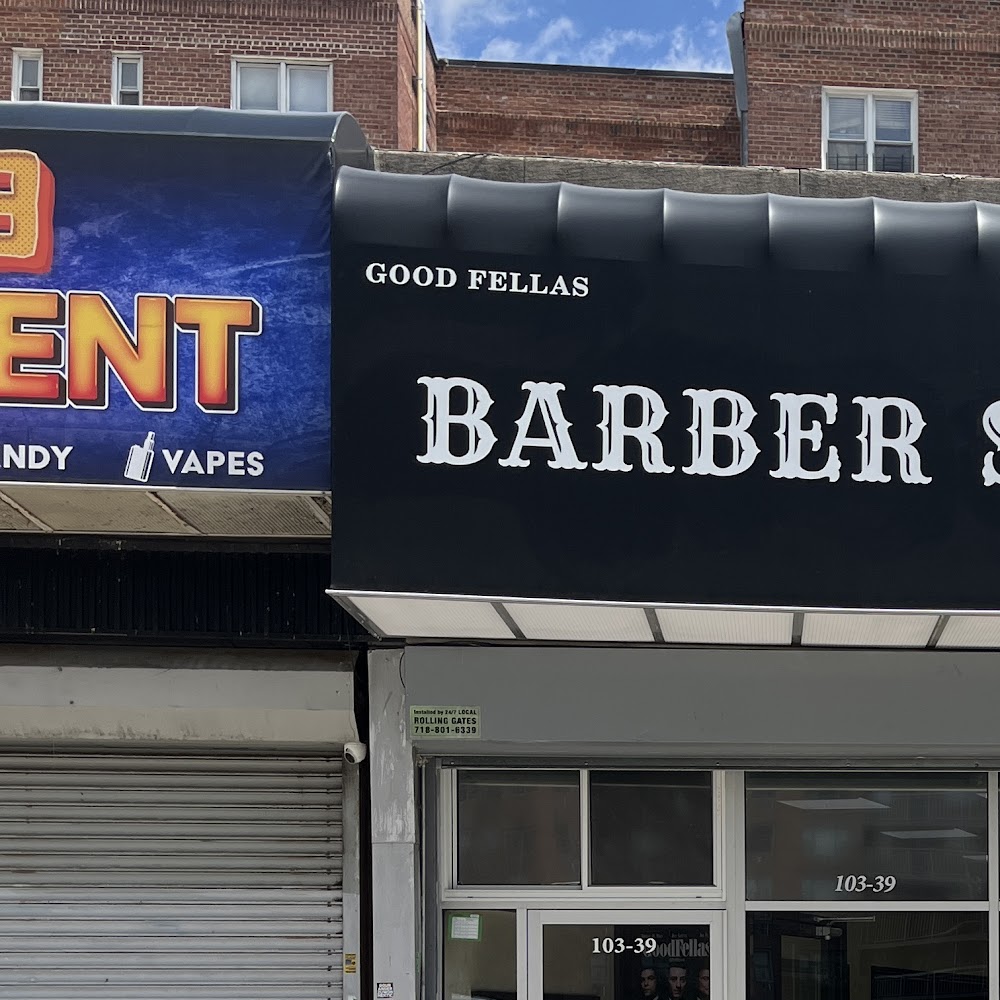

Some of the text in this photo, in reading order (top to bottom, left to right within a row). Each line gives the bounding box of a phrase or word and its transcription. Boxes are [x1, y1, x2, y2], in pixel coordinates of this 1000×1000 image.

[365, 263, 590, 298] GOOD FELLAS
[416, 376, 932, 485] BARBER
[0, 445, 73, 470] NDY
[162, 450, 265, 477] VAPES
[414, 716, 477, 725] ROLLING GATES
[414, 726, 477, 734] 718-801-6339
[835, 875, 897, 893] 103-39
[592, 937, 657, 954] 103-39
